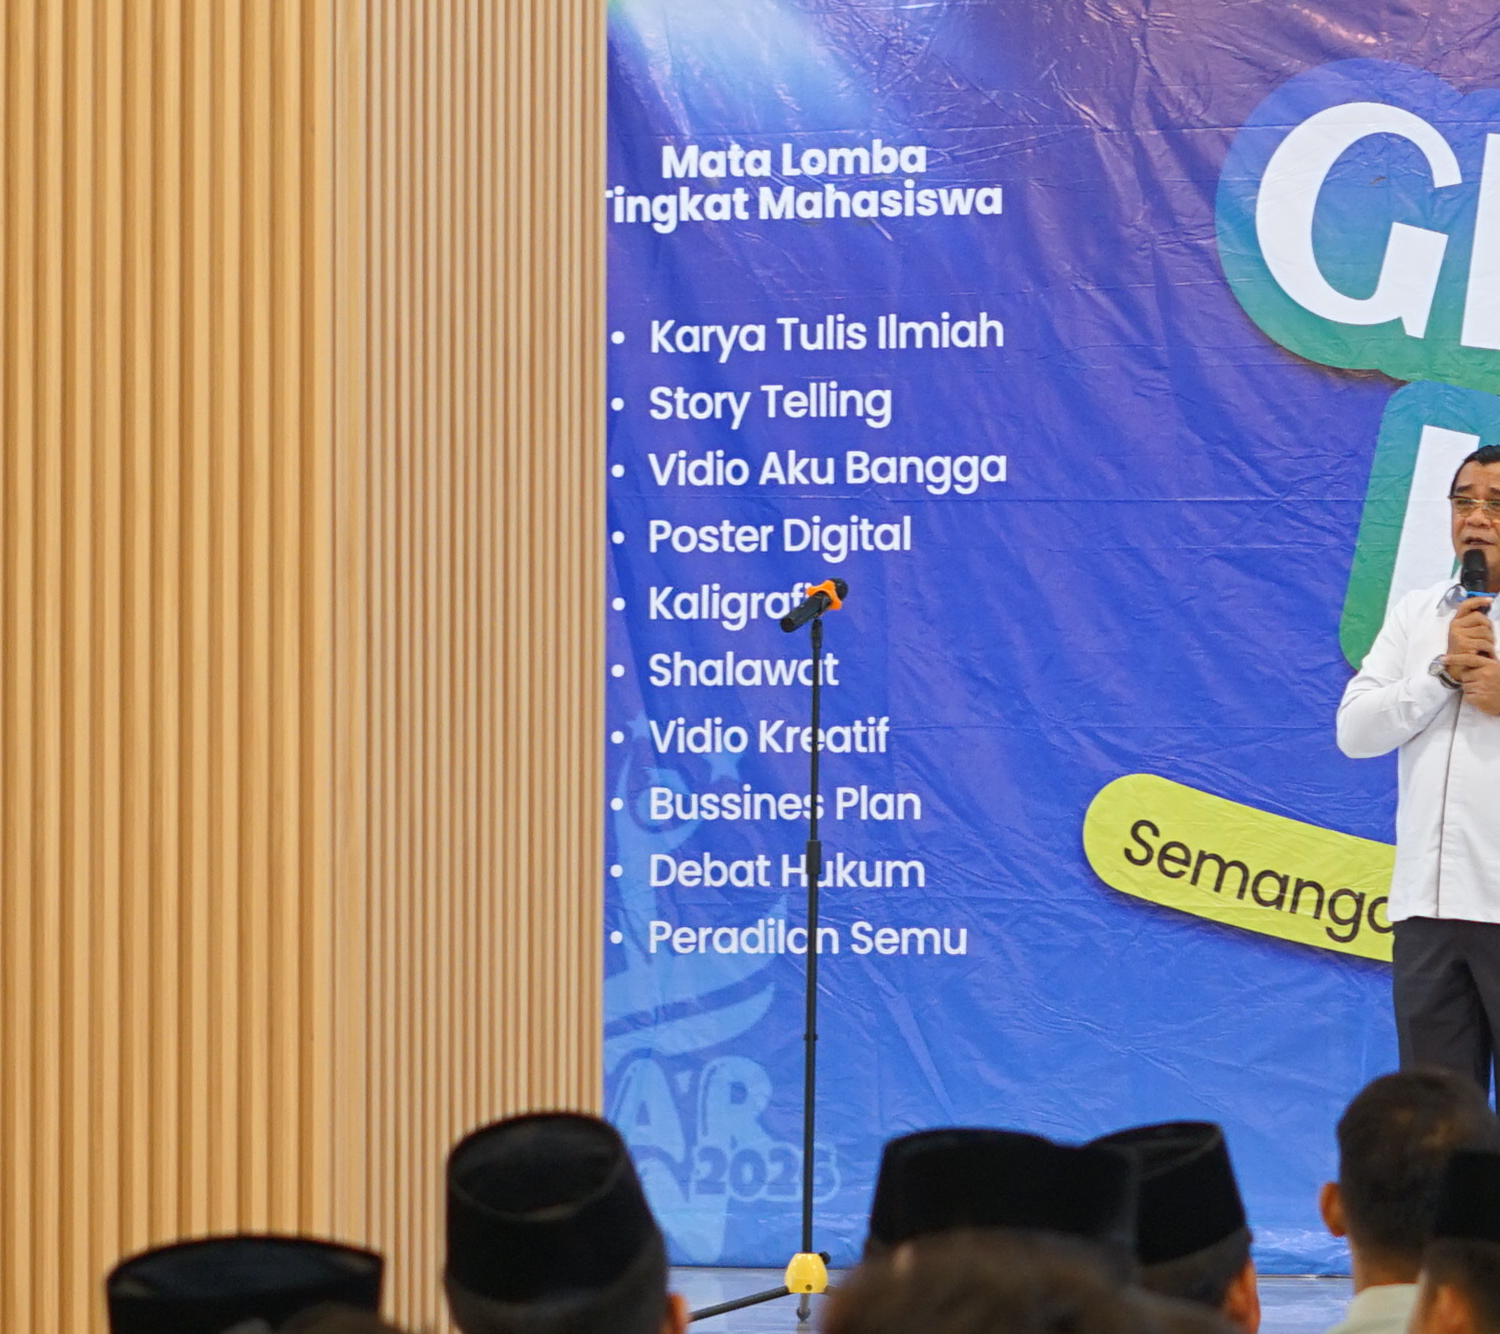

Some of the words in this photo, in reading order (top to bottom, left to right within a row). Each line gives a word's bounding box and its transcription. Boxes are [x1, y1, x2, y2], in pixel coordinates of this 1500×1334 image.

[661, 144, 772, 180] Mata
[781, 139, 928, 177] Lomba
[607, 184, 749, 234] ingkat
[758, 180, 1003, 221] Mahasiswa
[650, 319, 766, 364] Karya
[775, 313, 868, 351] Tulis
[877, 311, 1005, 350] Ilmiah
[649, 386, 752, 430] Story
[759, 380, 892, 429] Telling
[647, 449, 750, 487] Vidio
[758, 449, 835, 486] Aku
[845, 450, 1008, 496] Bangga
[649, 519, 774, 553] Poster
[783, 514, 912, 564] Digital
[649, 651, 840, 687] Shalawat
[649, 716, 749, 754] Vidio
[759, 716, 890, 753] Kreatif
[650, 784, 824, 820] Bussines
[835, 784, 922, 821] Plan
[649, 851, 772, 888] Debat
[781, 852, 926, 887] Hukum
[649, 918, 840, 954] Peradilan
[850, 920, 968, 956] Semu
